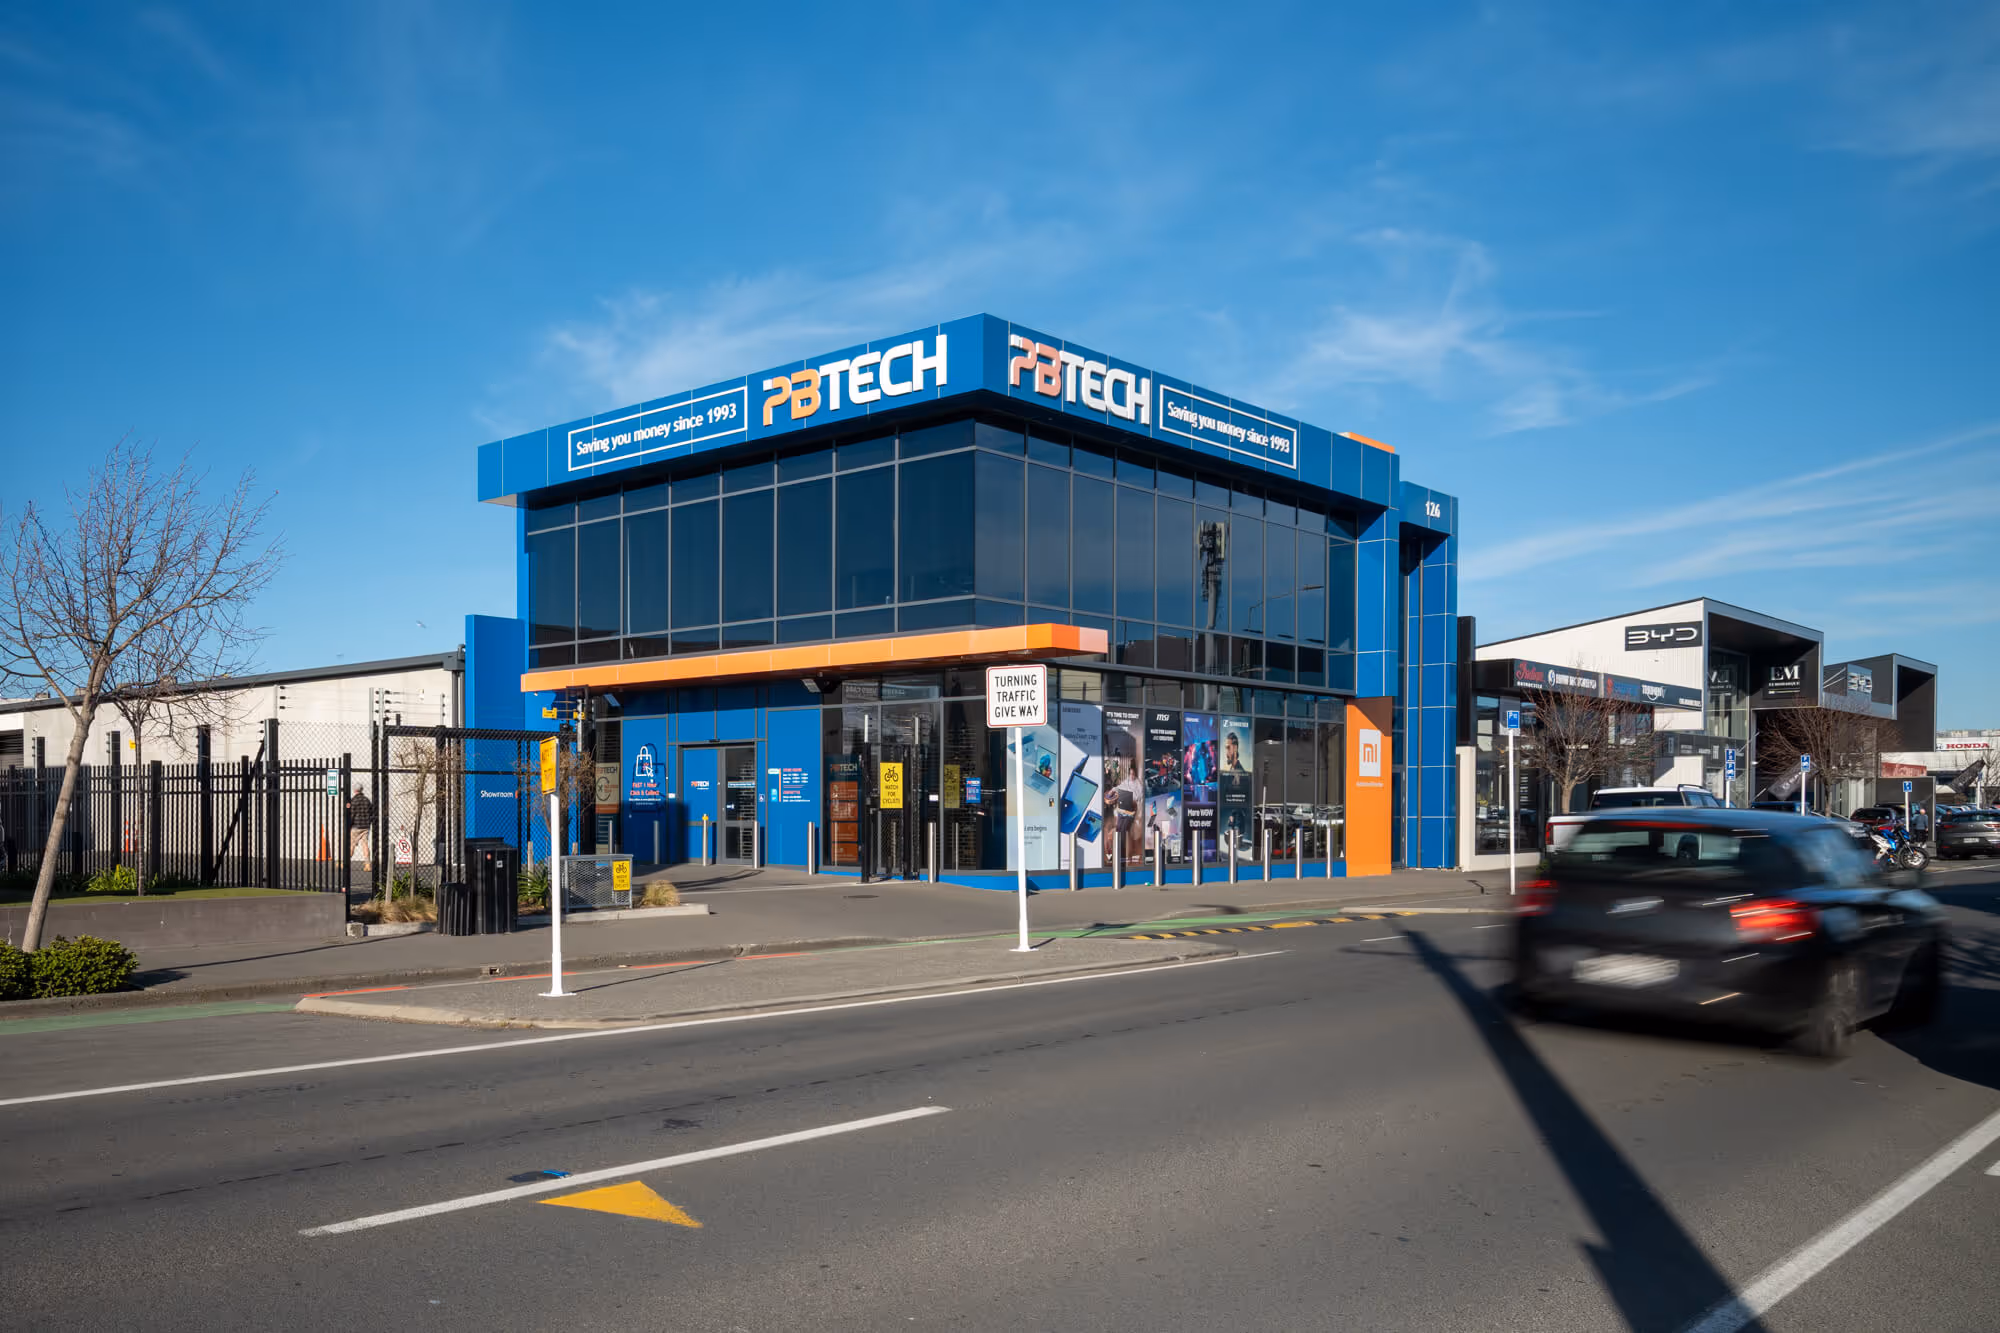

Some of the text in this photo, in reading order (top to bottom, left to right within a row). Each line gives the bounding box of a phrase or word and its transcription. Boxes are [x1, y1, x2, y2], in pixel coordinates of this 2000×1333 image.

[763, 334, 948, 427] PBTECH
[1010, 333, 1151, 425] PBTECH
[576, 403, 737, 456] Saving you money since 1993
[1167, 401, 1290, 453] Saving you money since 1993
[1425, 500, 1441, 518] 126
[1628, 627, 1698, 644] BYD
[1770, 664, 1801, 681] EM
[994, 674, 1037, 688] TURNING
[996, 689, 1036, 703] TRAFFIC
[994, 704, 1039, 718] GIVE WAY
[1946, 742, 1990, 750] HONDA
[480, 789, 514, 798] Showroom
[1187, 808, 1200, 817] More
[1189, 819, 1201, 827] than
